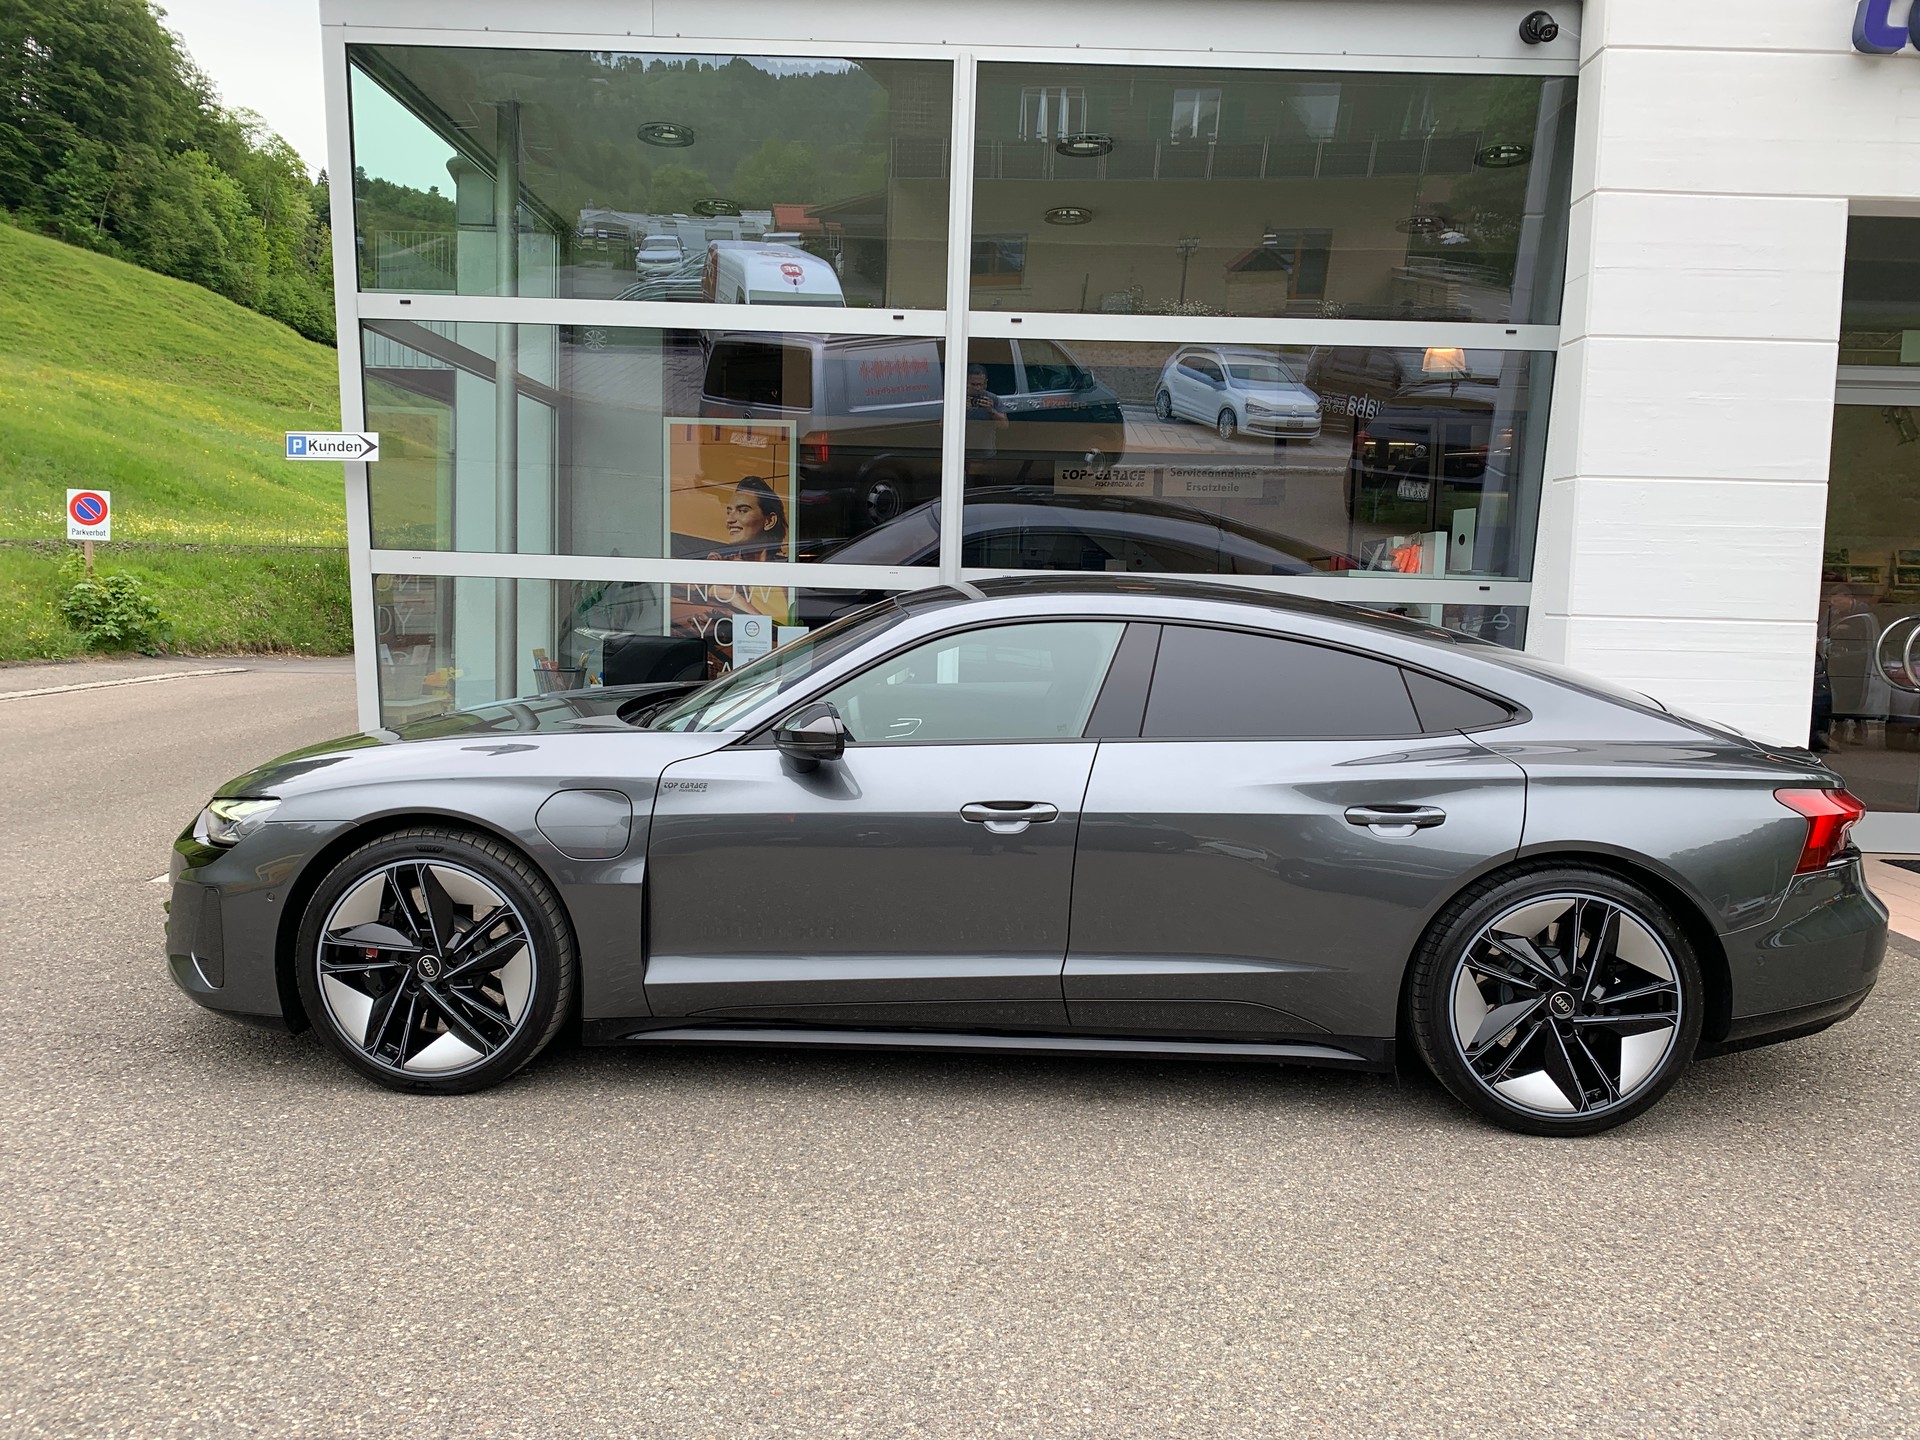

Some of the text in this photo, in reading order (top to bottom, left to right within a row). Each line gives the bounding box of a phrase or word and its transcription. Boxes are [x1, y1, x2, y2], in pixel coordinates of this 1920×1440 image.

[308, 440, 362, 452] Kunden
[1169, 467, 1257, 479] Serviceannahme
[1186, 481, 1240, 492] Ersatzteile
[71, 528, 106, 537] Parkverbot
[686, 584, 773, 604] NOW
[692, 617, 733, 647] YO
